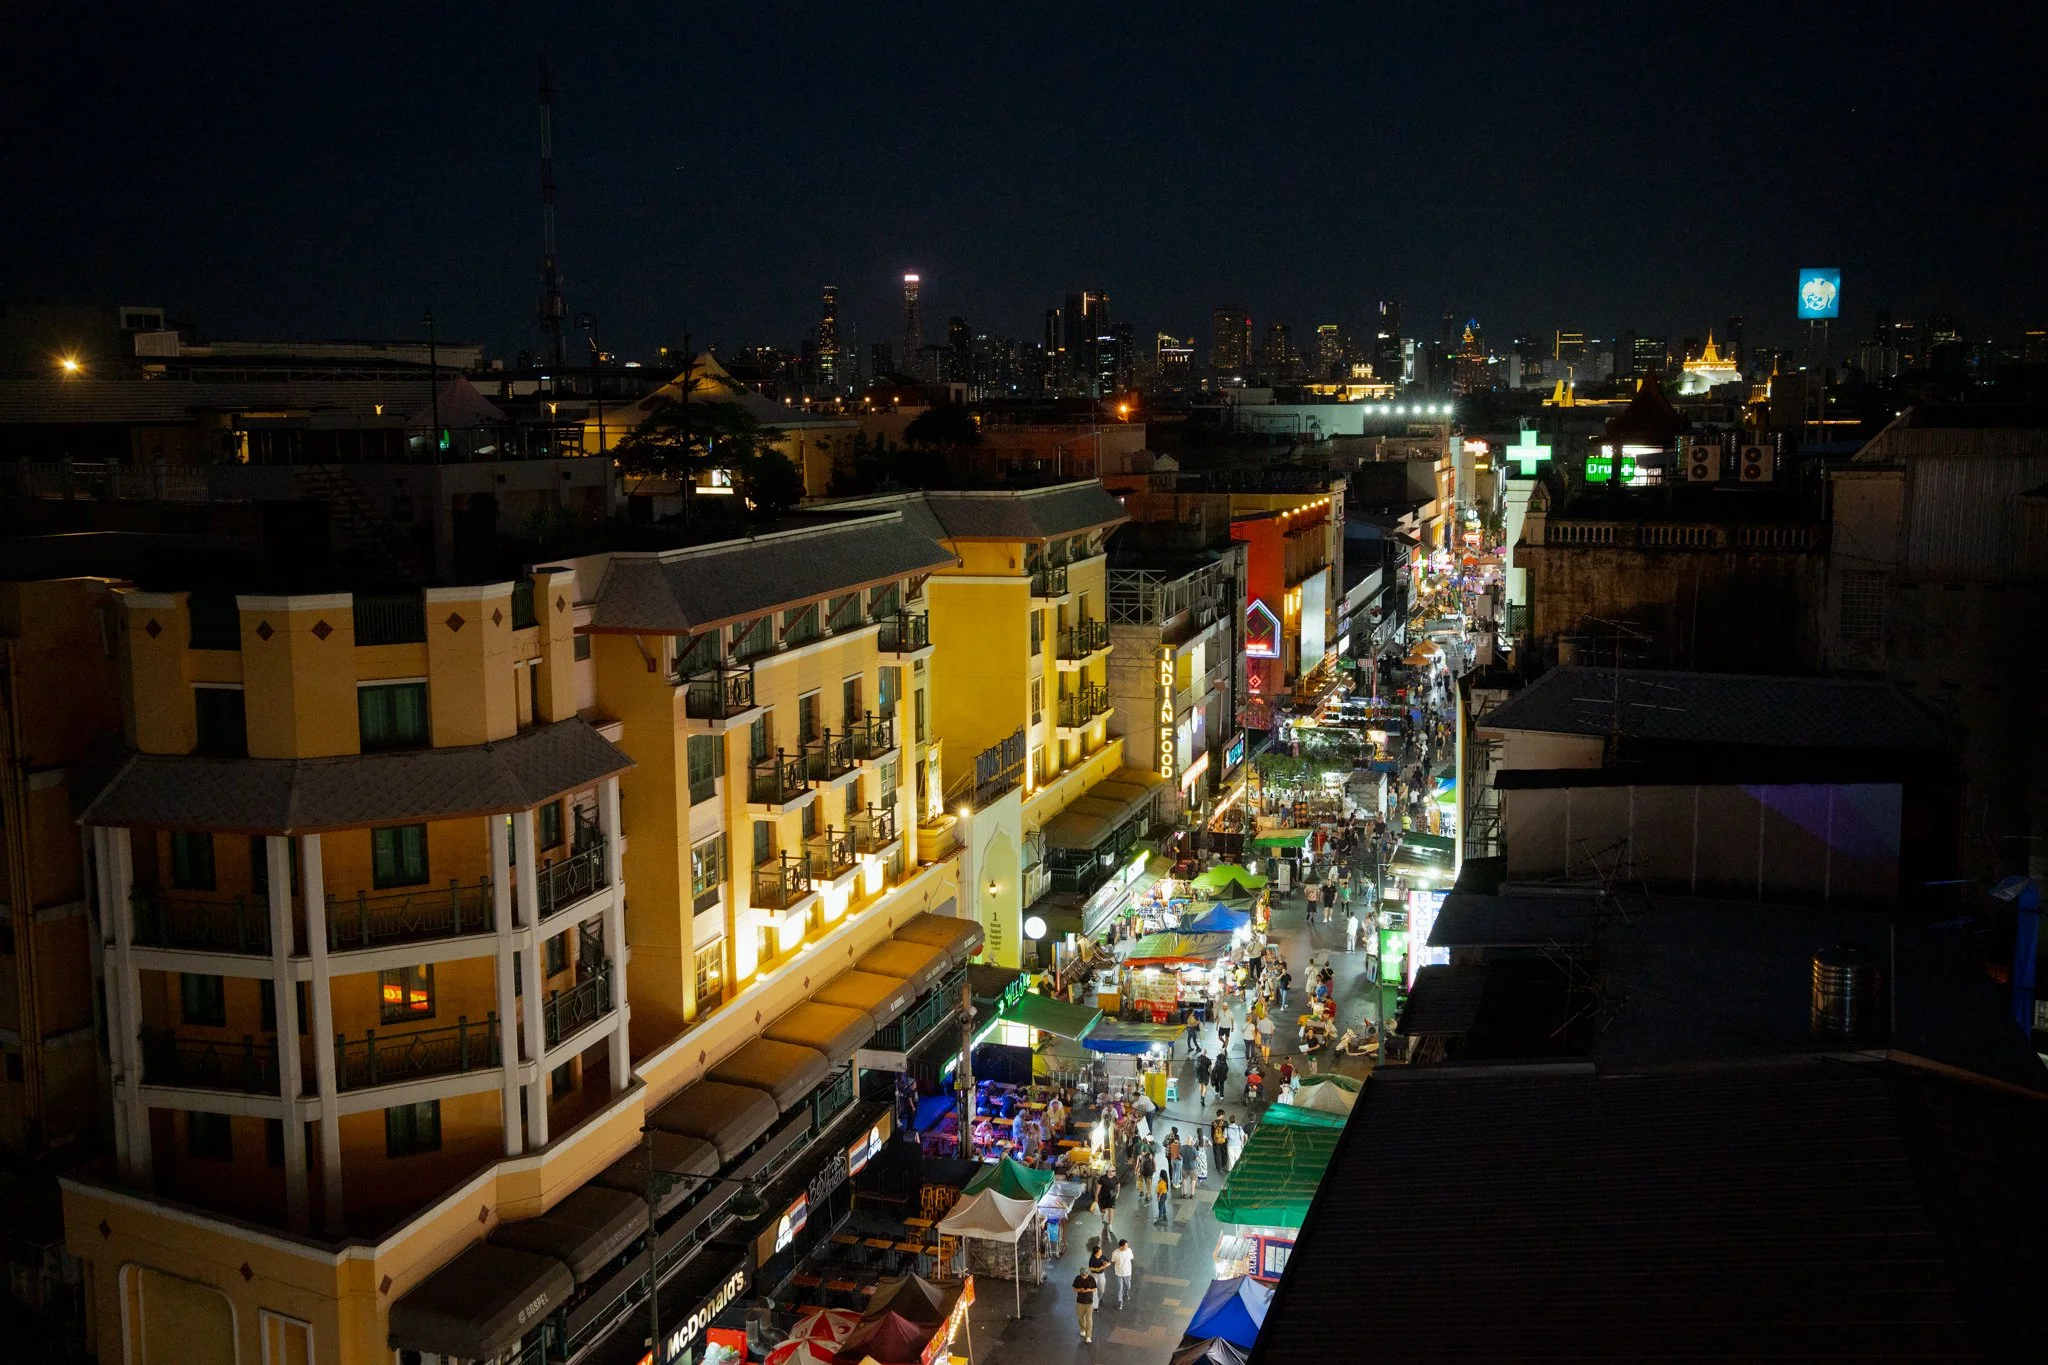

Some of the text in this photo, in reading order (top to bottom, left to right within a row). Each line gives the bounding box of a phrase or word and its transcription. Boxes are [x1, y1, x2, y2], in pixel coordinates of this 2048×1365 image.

[1588, 463, 1613, 475] Dru
[1161, 648, 1173, 779] INDIAN FOOD
[1416, 892, 1428, 967] EXCHAN
[526, 1292, 549, 1319] GOSPEL
[666, 1270, 745, 1362] McDonald's
